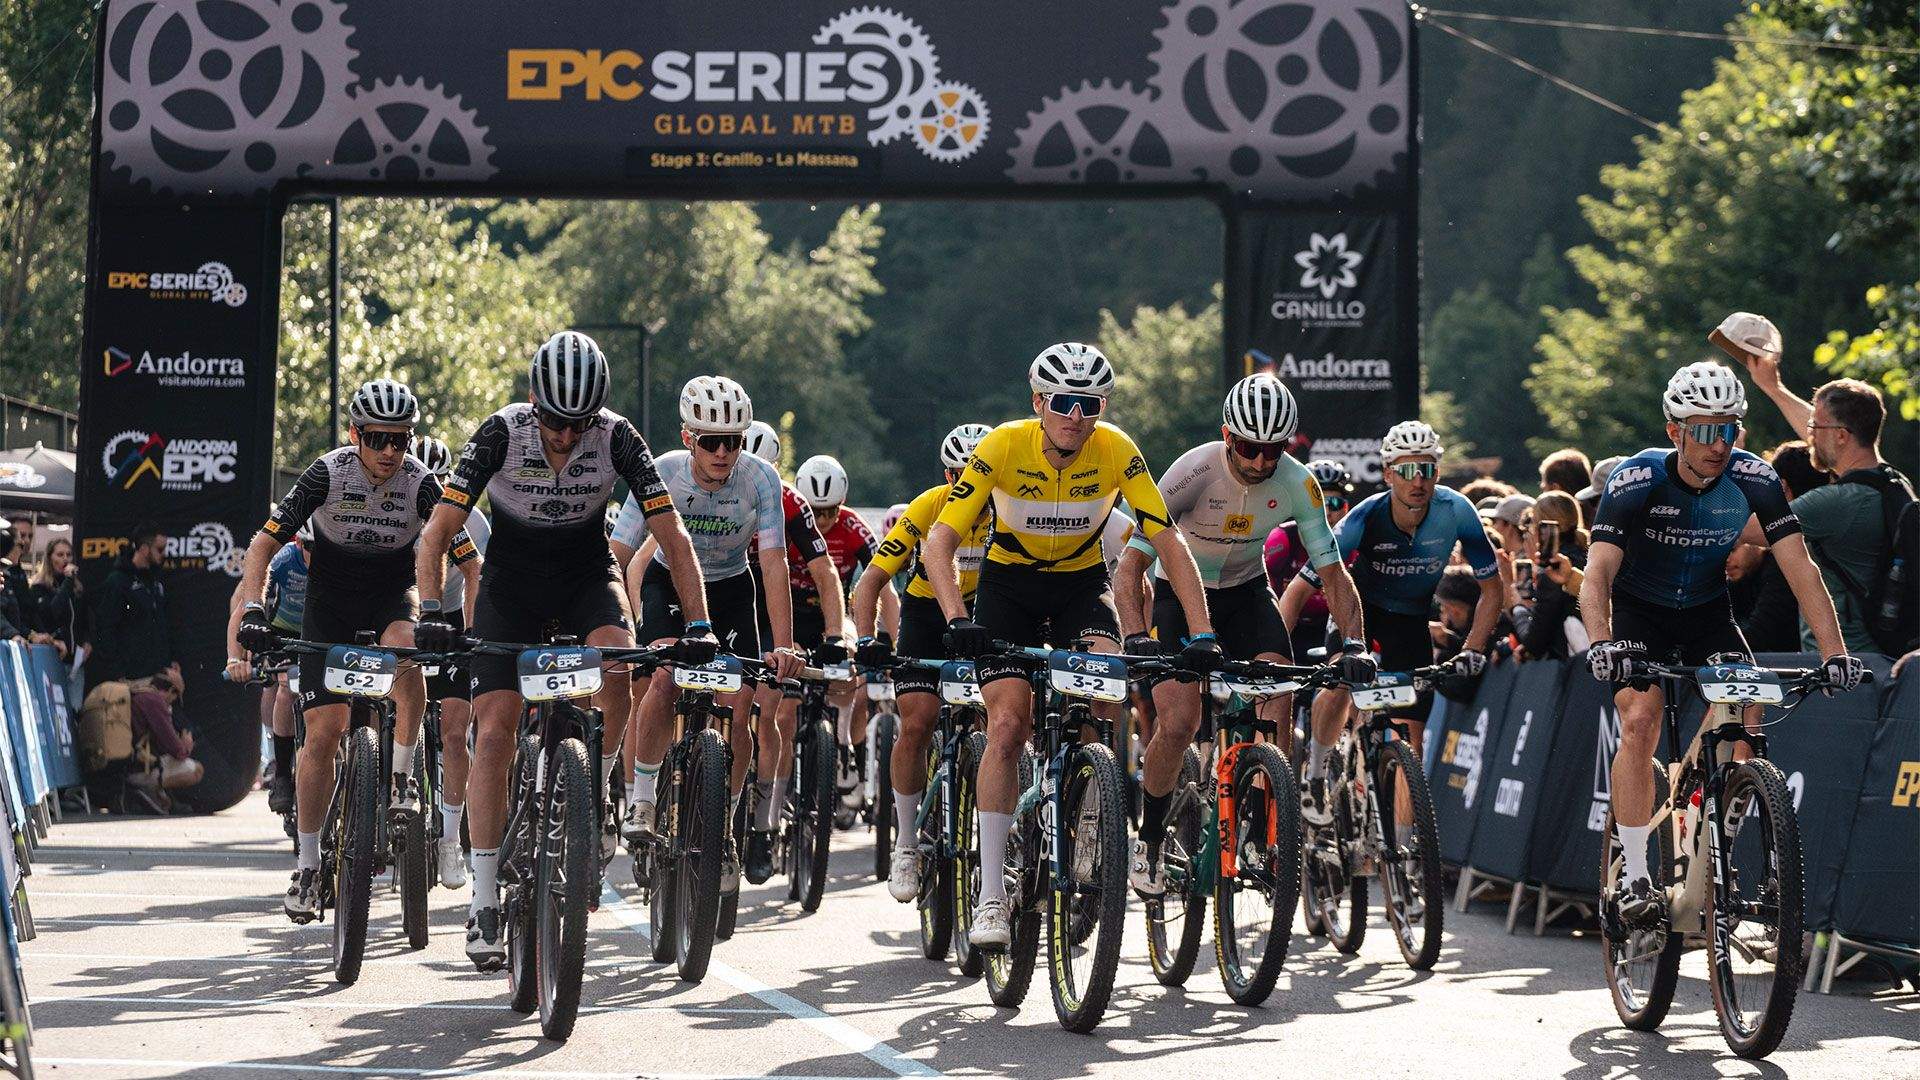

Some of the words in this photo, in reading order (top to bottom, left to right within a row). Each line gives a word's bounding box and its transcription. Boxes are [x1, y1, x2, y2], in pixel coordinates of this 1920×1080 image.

[508, 49, 644, 100] EPIC
[650, 50, 889, 102] SERIES
[654, 114, 776, 135] GLOBAL
[792, 114, 857, 135] MTB
[651, 152, 693, 169] Stage
[697, 152, 710, 167] 3:
[713, 152, 764, 167] Canillo
[776, 152, 794, 167] La
[797, 153, 859, 168] Massana
[108, 272, 148, 289] EPIC
[150, 273, 219, 290] SERIES
[1271, 300, 1366, 319] CANILLO
[135, 351, 245, 375] Andorra
[1279, 352, 1391, 378] Andorra
[158, 376, 245, 388] visitandorra.com
[164, 439, 237, 455] ANDORRA
[162, 454, 236, 482] EPIC
[1731, 459, 1778, 481] KTM
[1608, 466, 1652, 494] KTM
[512, 484, 602, 496] cannondale
[333, 514, 408, 528] cannondale
[1026, 517, 1091, 527] KLIMATIZA
[164, 536, 216, 558] RIES
[360, 661, 381, 670] EPIC
[557, 658, 583, 668] EPIC
[1086, 664, 1110, 674] EPIC
[344, 672, 374, 688] 6-2
[546, 674, 576, 690] 6-1
[687, 672, 728, 685] 25-2
[1073, 675, 1105, 691] 3-2
[963, 685, 980, 698] 3-
[1373, 689, 1397, 701] 2-1
[1725, 684, 1761, 696] 2-2
